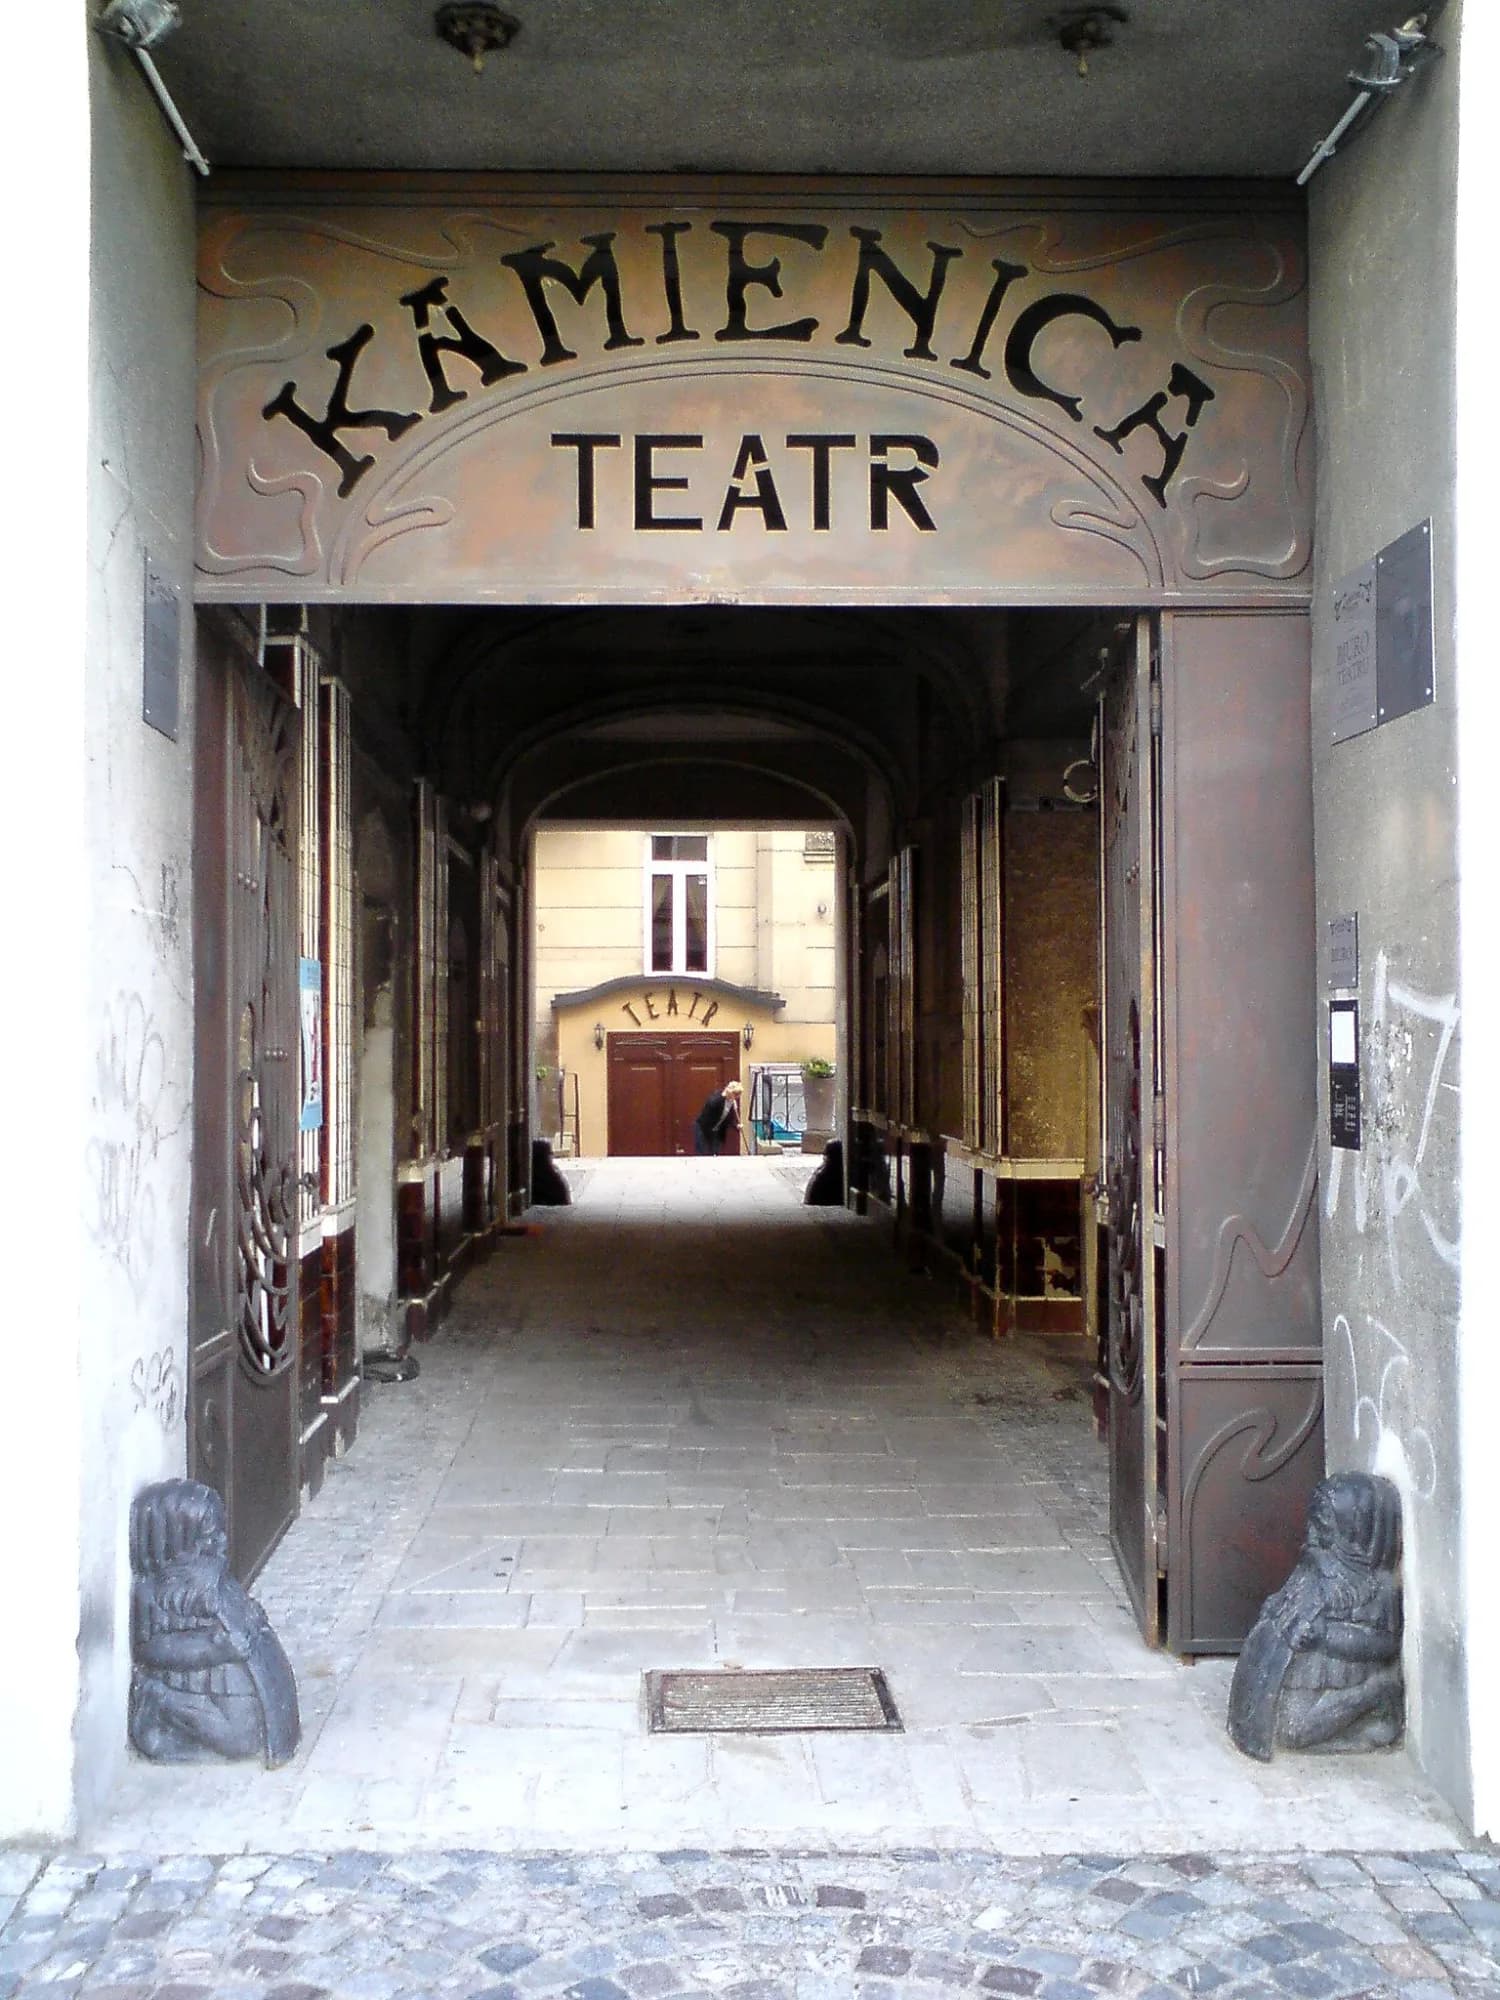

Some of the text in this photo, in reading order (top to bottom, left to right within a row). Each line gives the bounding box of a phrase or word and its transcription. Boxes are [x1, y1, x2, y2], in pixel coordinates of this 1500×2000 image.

[262, 220, 1215, 508] KAMIENICA
[551, 433, 939, 531] TEATR
[622, 989, 719, 1027] TEATR
